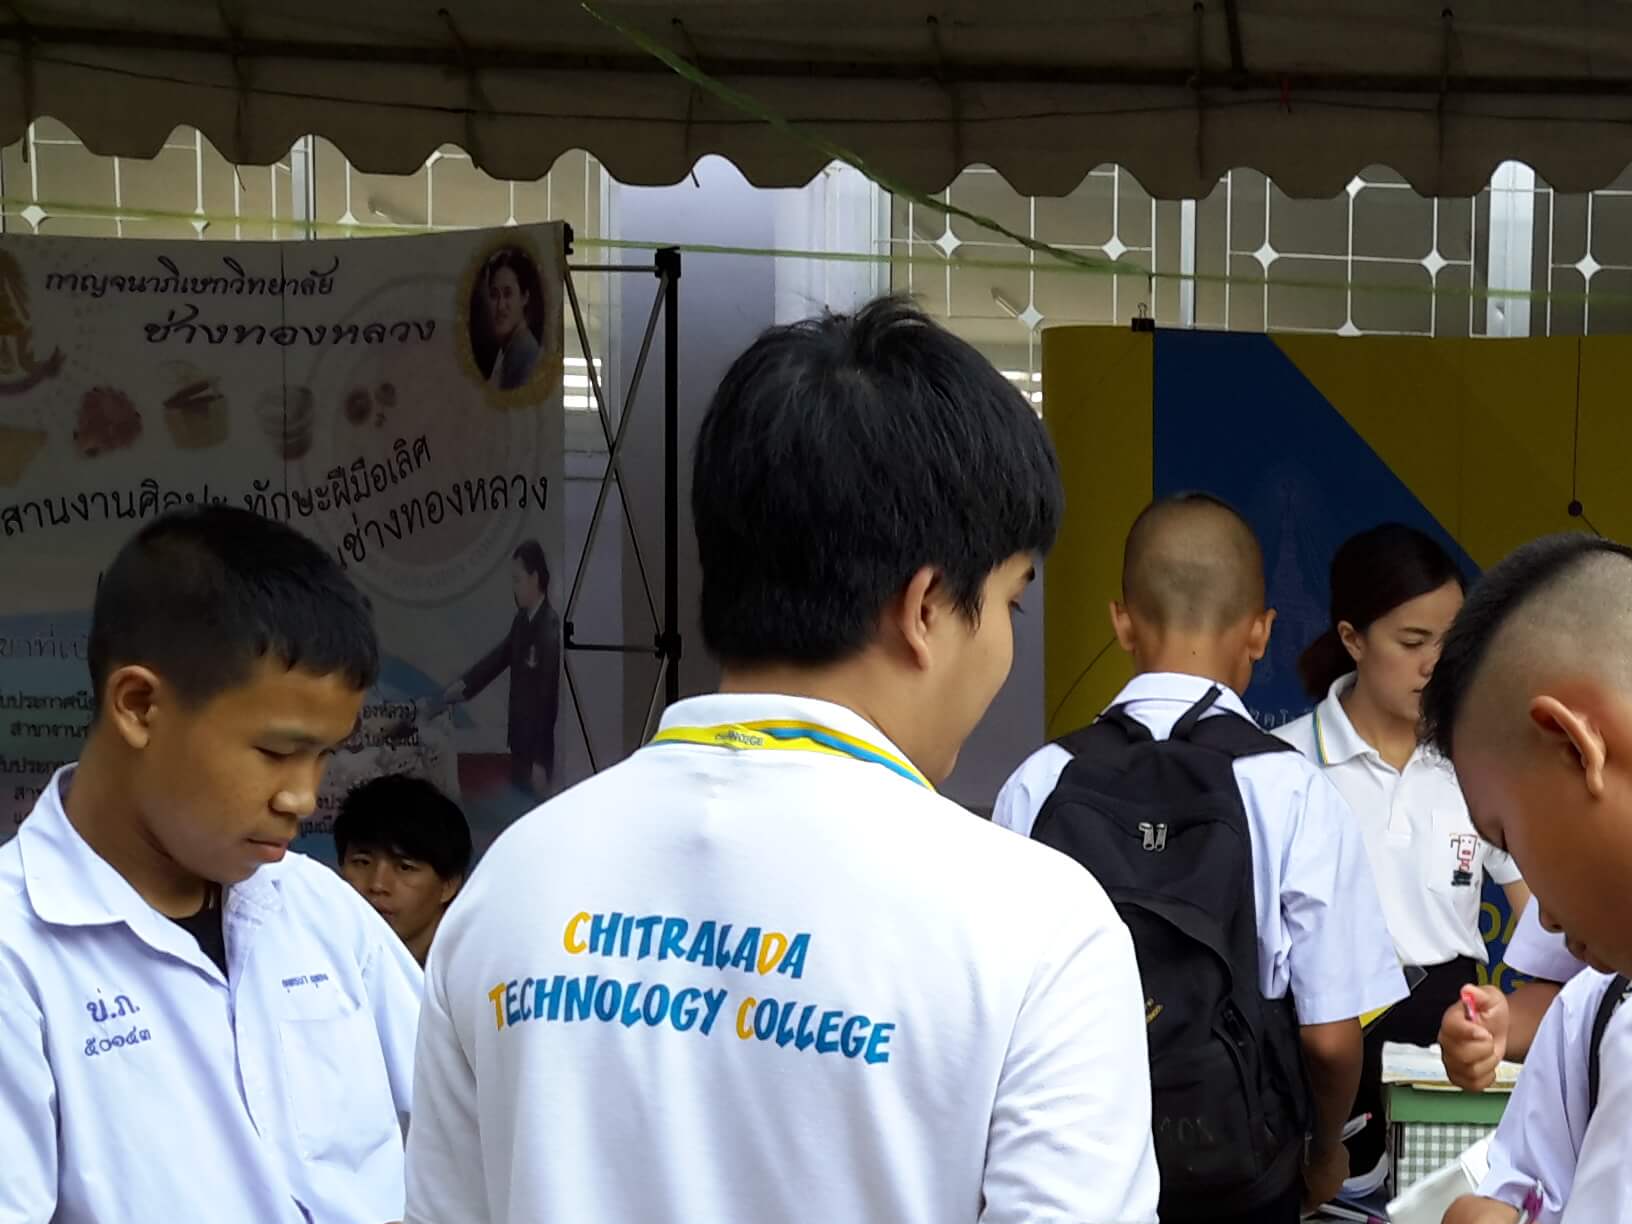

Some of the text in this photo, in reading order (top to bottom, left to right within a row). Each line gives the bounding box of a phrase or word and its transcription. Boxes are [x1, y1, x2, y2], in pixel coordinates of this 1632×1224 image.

[143, 304, 437, 346] ช่างทองหลวง
[563, 911, 812, 979] CHITRALADA
[488, 975, 896, 1065] TECHNOLOGY COLLEGE
